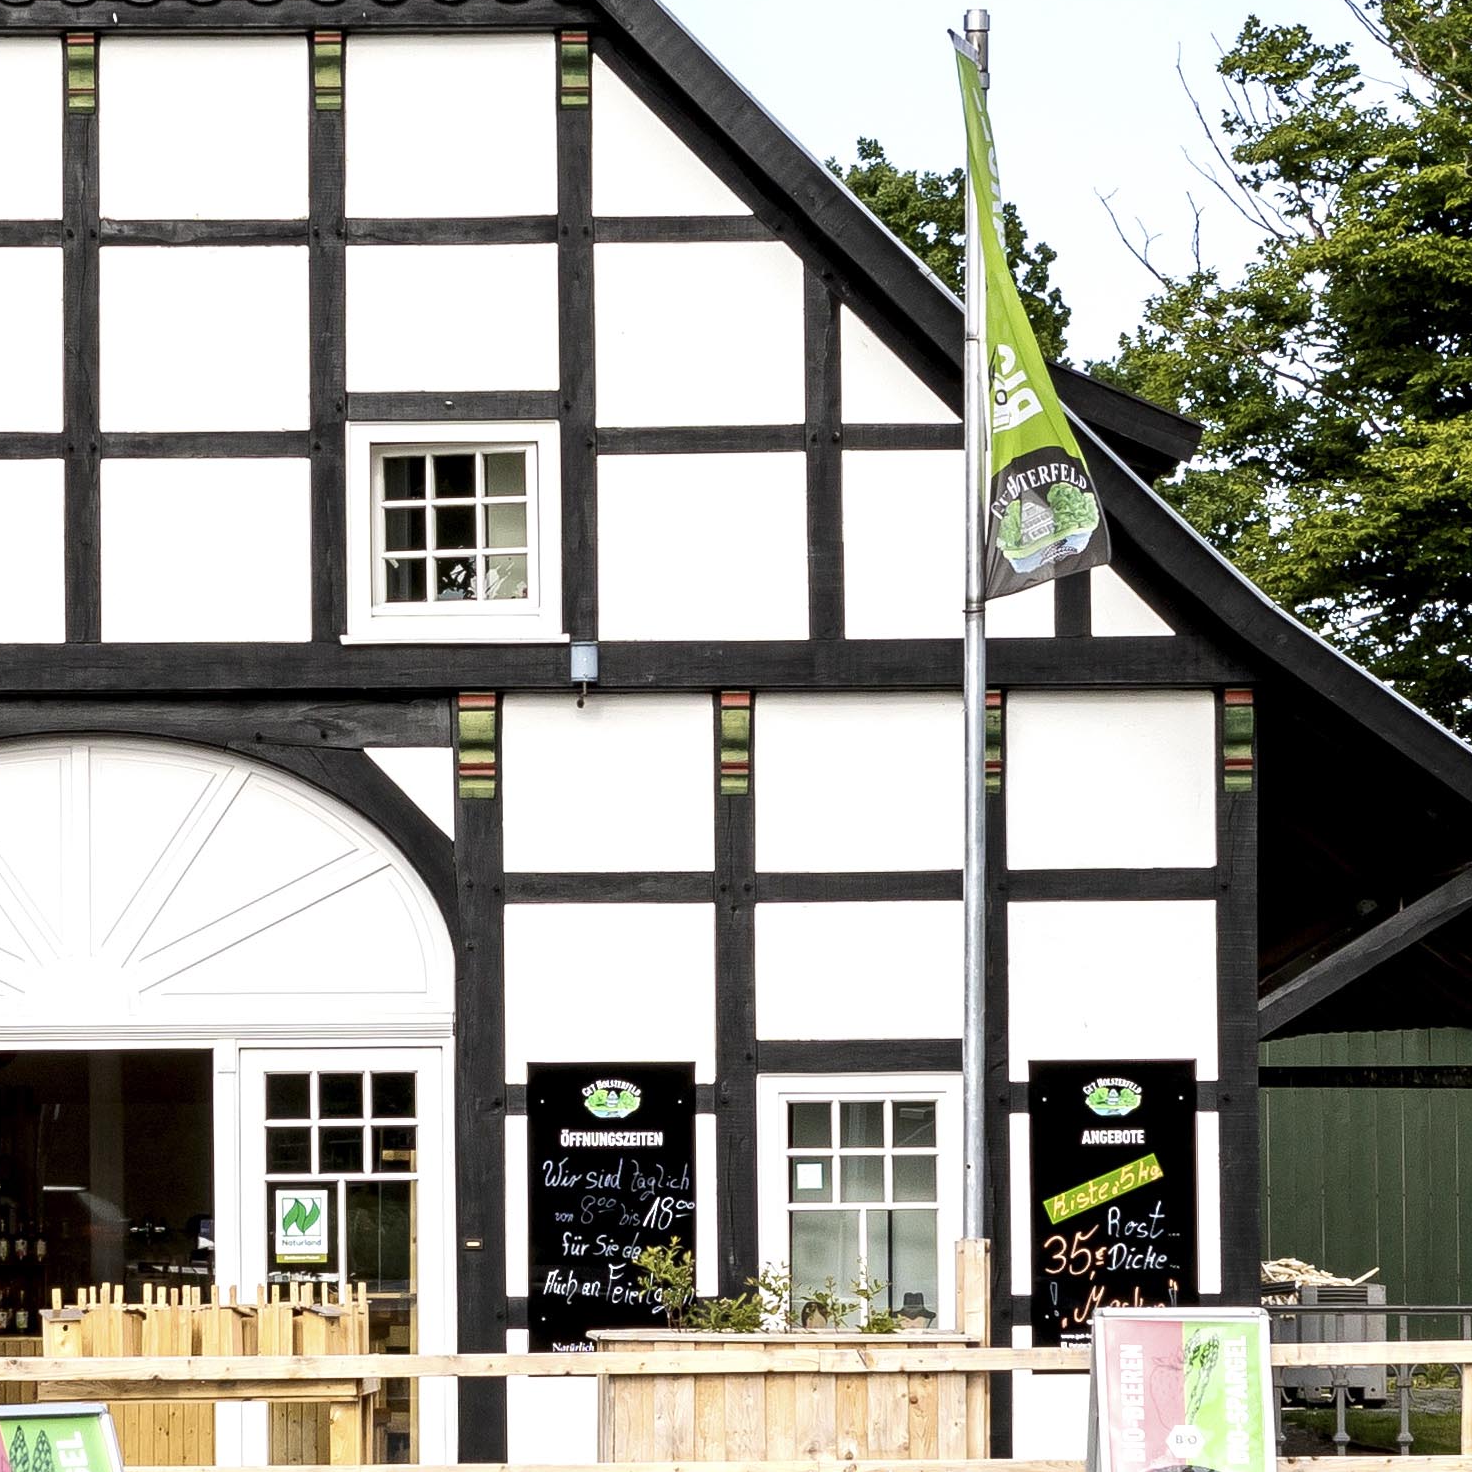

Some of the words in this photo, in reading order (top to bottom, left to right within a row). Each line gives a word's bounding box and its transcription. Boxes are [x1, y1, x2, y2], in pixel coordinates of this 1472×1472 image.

[560, 1129, 663, 1147] ÖFFNUNGSZEITEN
[1081, 1130, 1145, 1144] ANGEBOTE
[542, 1157, 582, 1188] Wir
[585, 1158, 622, 1189] sind
[554, 1212, 574, 1223] von
[619, 1203, 641, 1226] bis
[562, 1231, 590, 1257] für
[593, 1234, 620, 1257] Sie
[581, 1280, 601, 1297] an
[1119, 1343, 1146, 1463] BIO-BEEREN
[1225, 1334, 1250, 1465] BIO-SPARGEL
